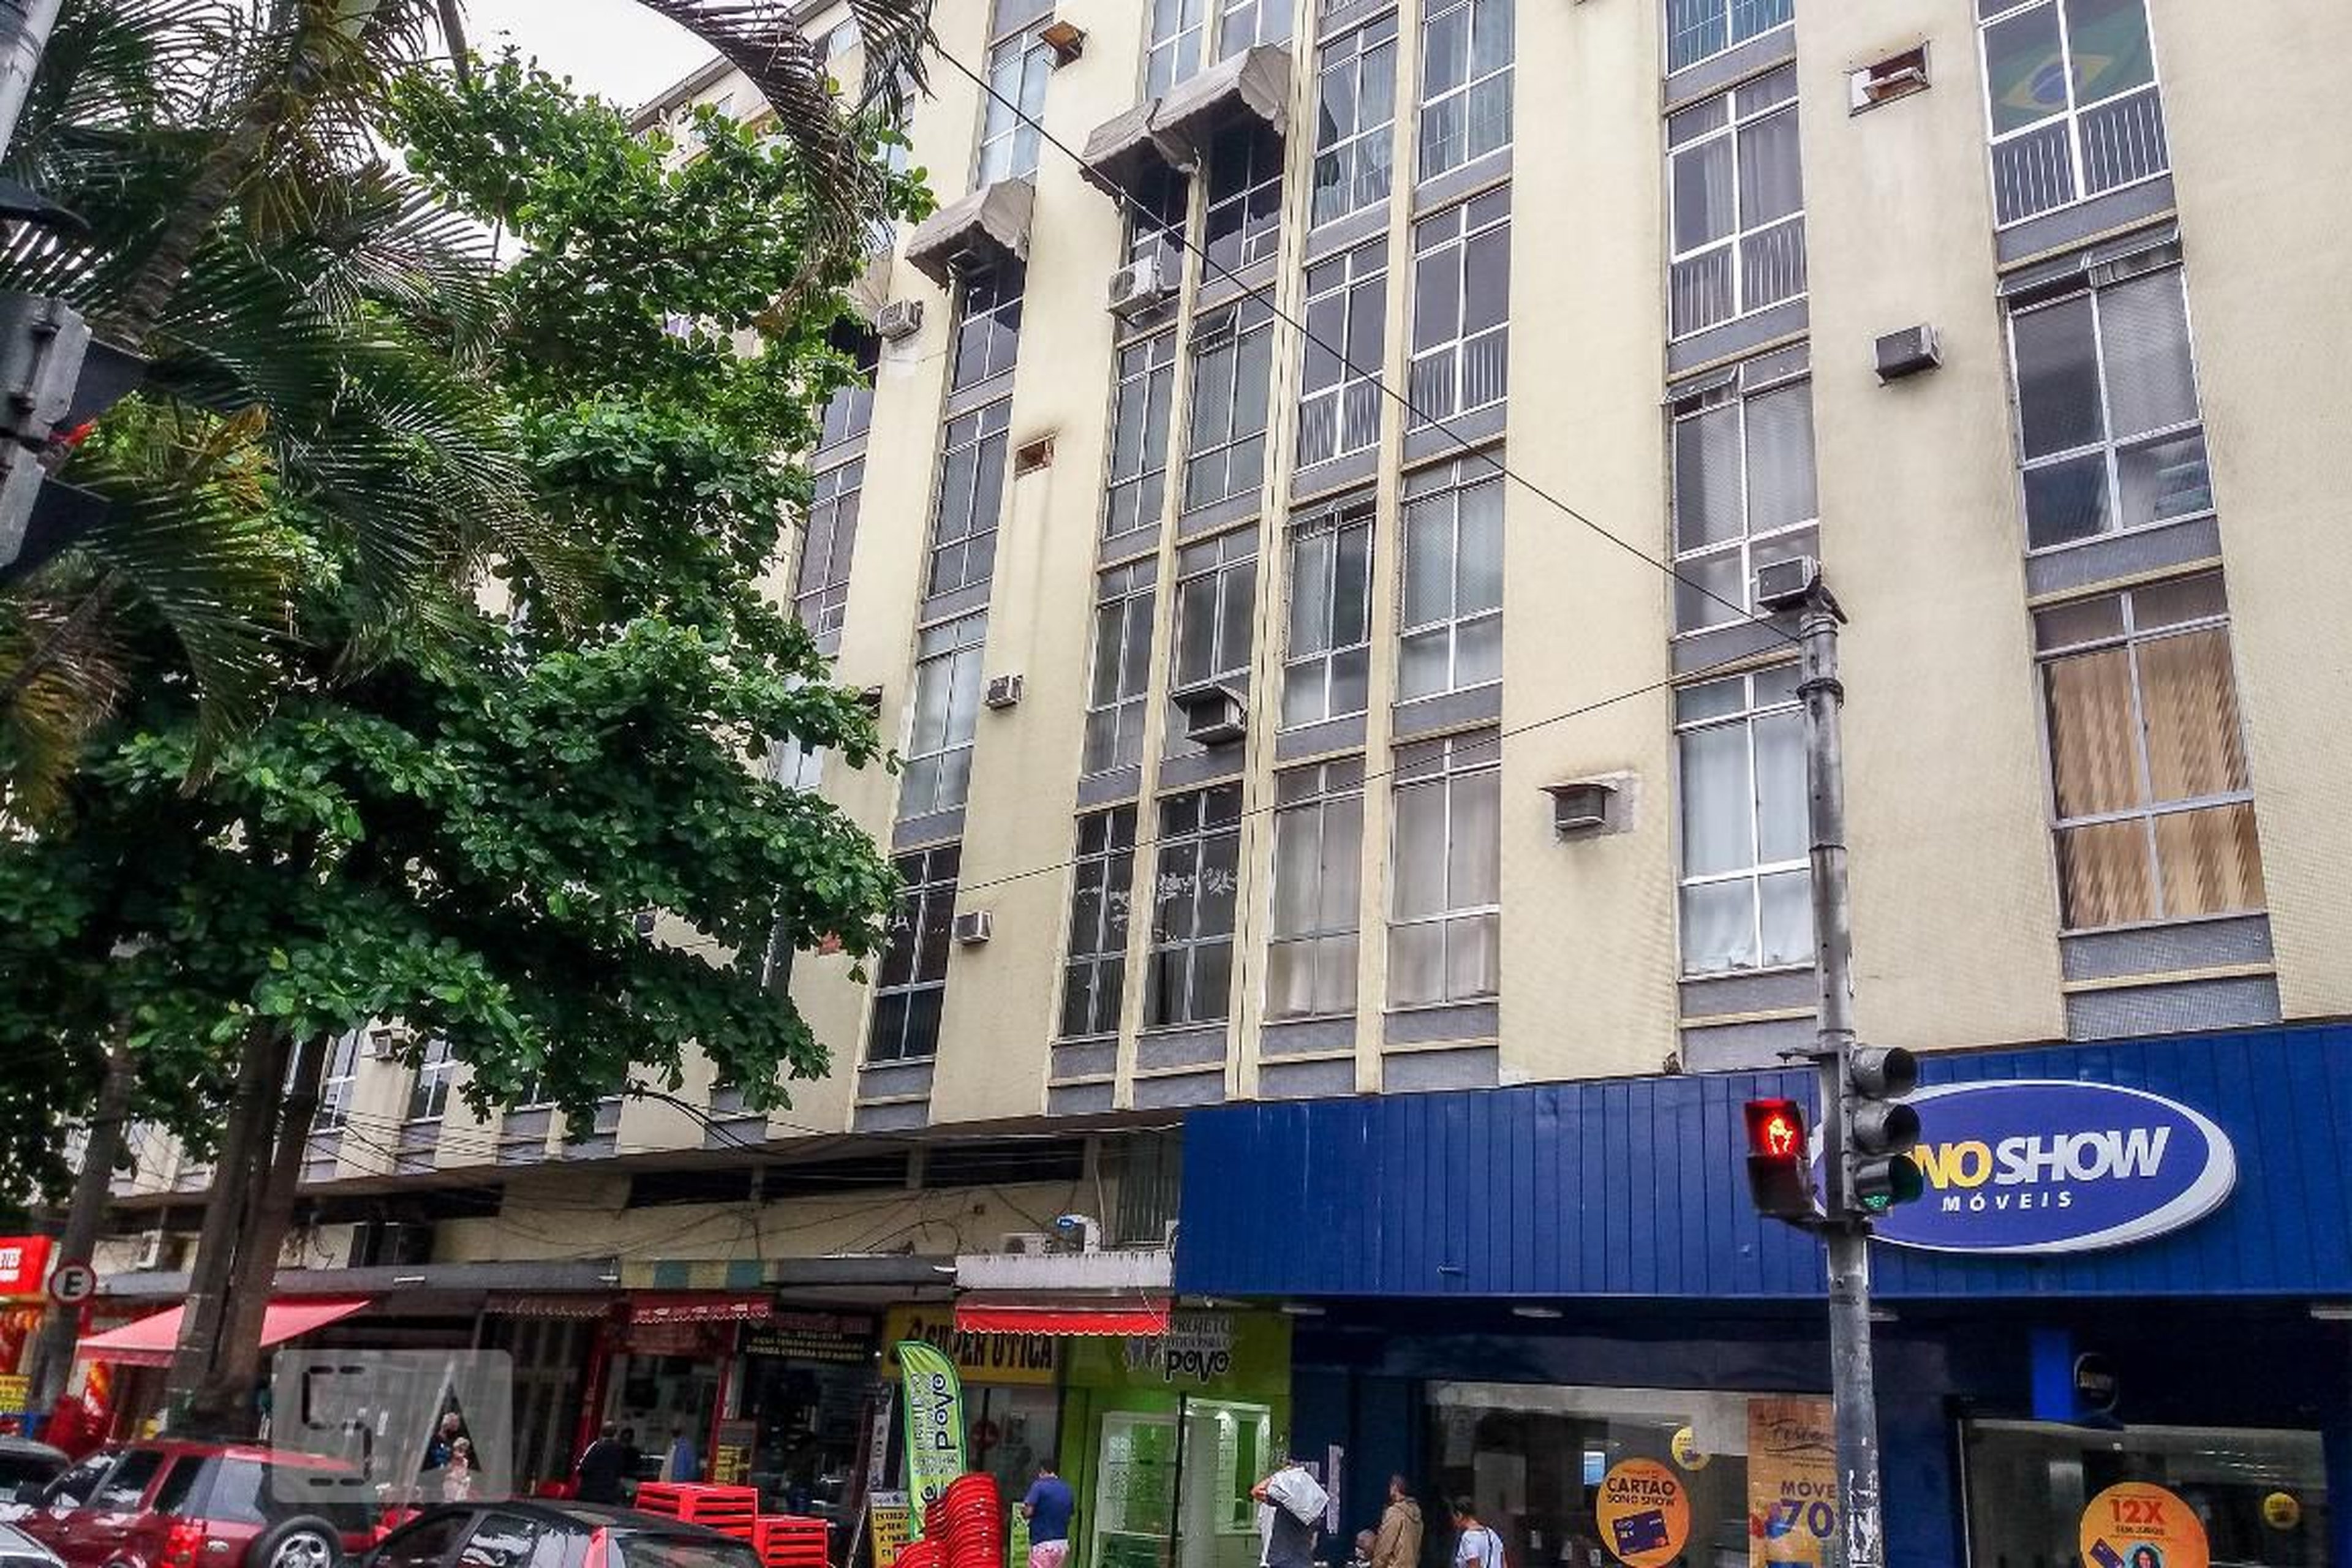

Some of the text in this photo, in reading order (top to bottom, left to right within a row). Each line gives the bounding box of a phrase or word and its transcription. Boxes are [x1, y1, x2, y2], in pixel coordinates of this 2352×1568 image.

[1941, 1191, 2073, 1212] MÓVEIS
[64, 1270, 84, 1296] E
[1607, 1476, 1676, 1496] CARTÃO
[1781, 1477, 1836, 1499] MÓVE
[2109, 1499, 2165, 1524] 12X
